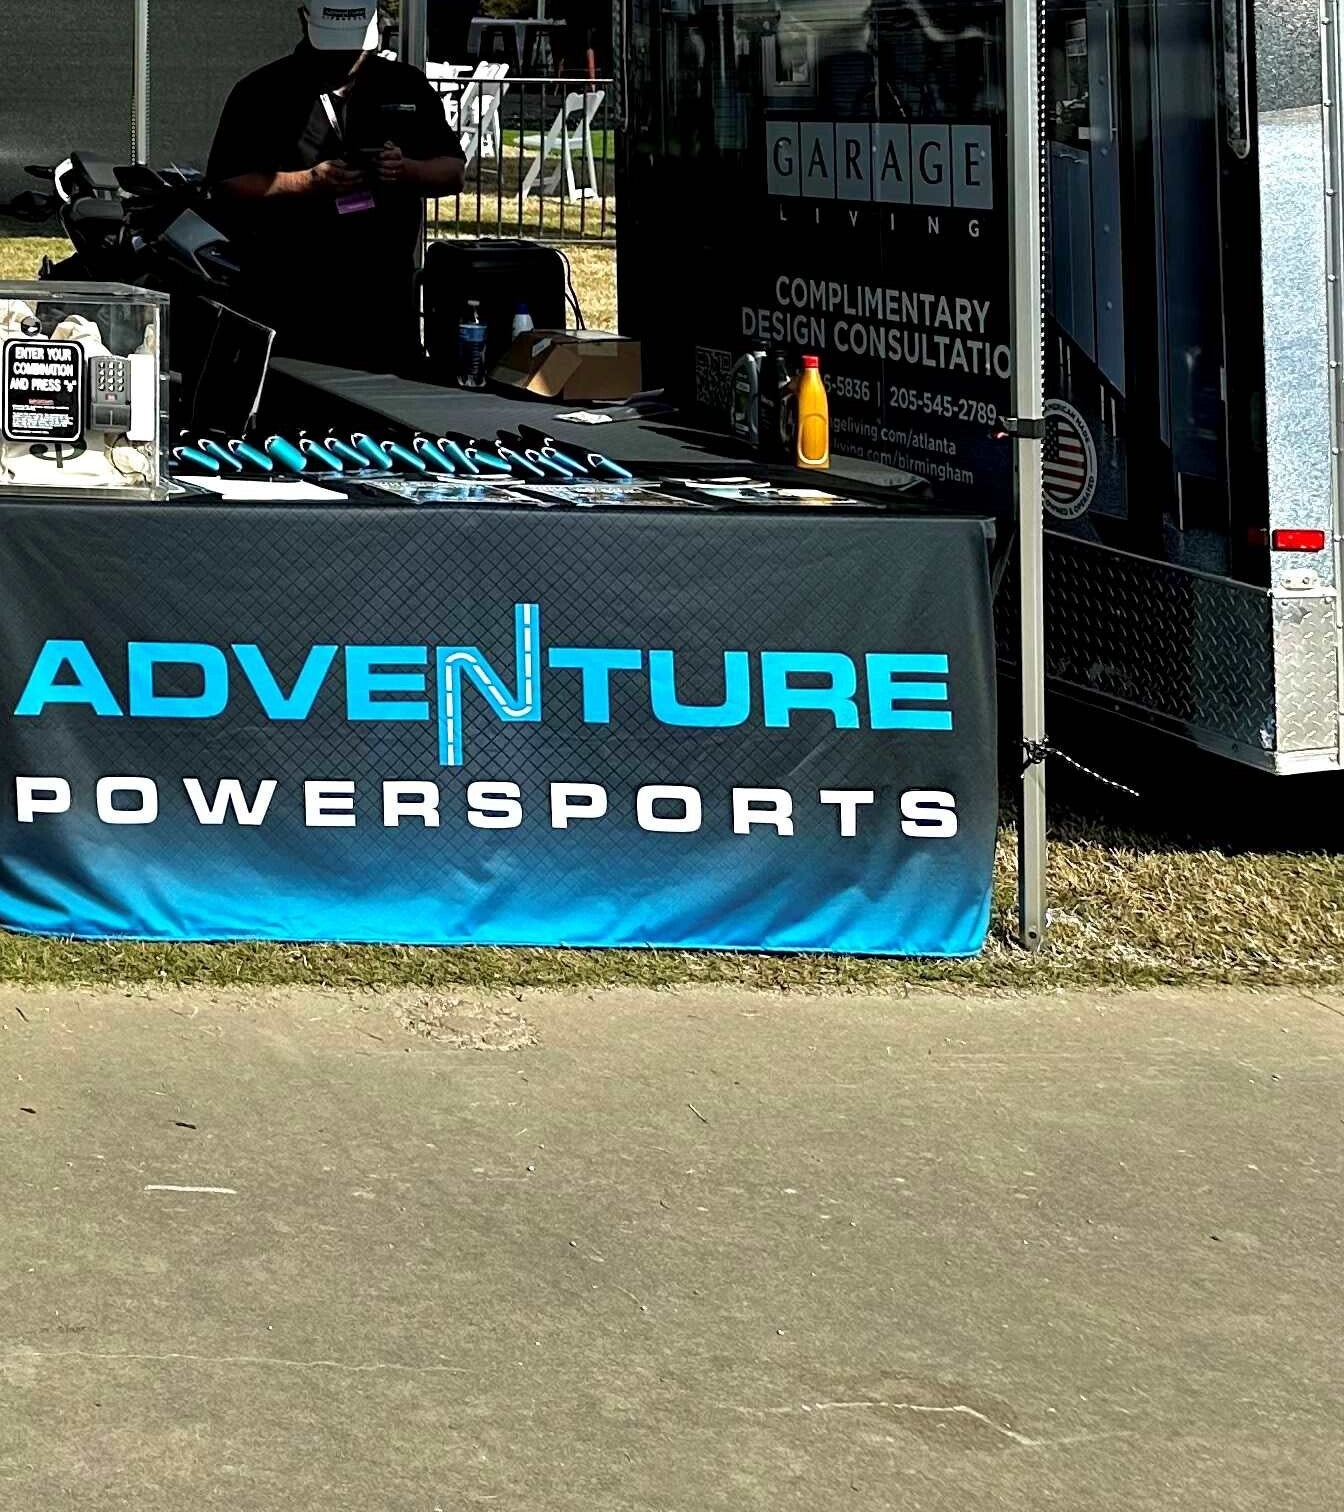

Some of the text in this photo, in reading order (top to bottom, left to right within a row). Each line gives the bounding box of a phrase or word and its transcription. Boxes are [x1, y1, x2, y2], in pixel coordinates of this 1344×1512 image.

[773, 137, 981, 186] GARAGE
[779, 204, 980, 237] LIVING
[776, 275, 990, 334] COMPLIMENTARY
[15, 347, 72, 361] ENTER YOUR
[741, 306, 1011, 379] DESIGN CONSULTATIO
[9, 377, 29, 390] AND
[31, 378, 61, 392] PRESS
[13, 362, 74, 376] COMBINATION
[889, 386, 997, 426] 205-545-2789
[13, 602, 954, 767] ADVENTURE
[13, 775, 959, 838] POWERSPORTS
